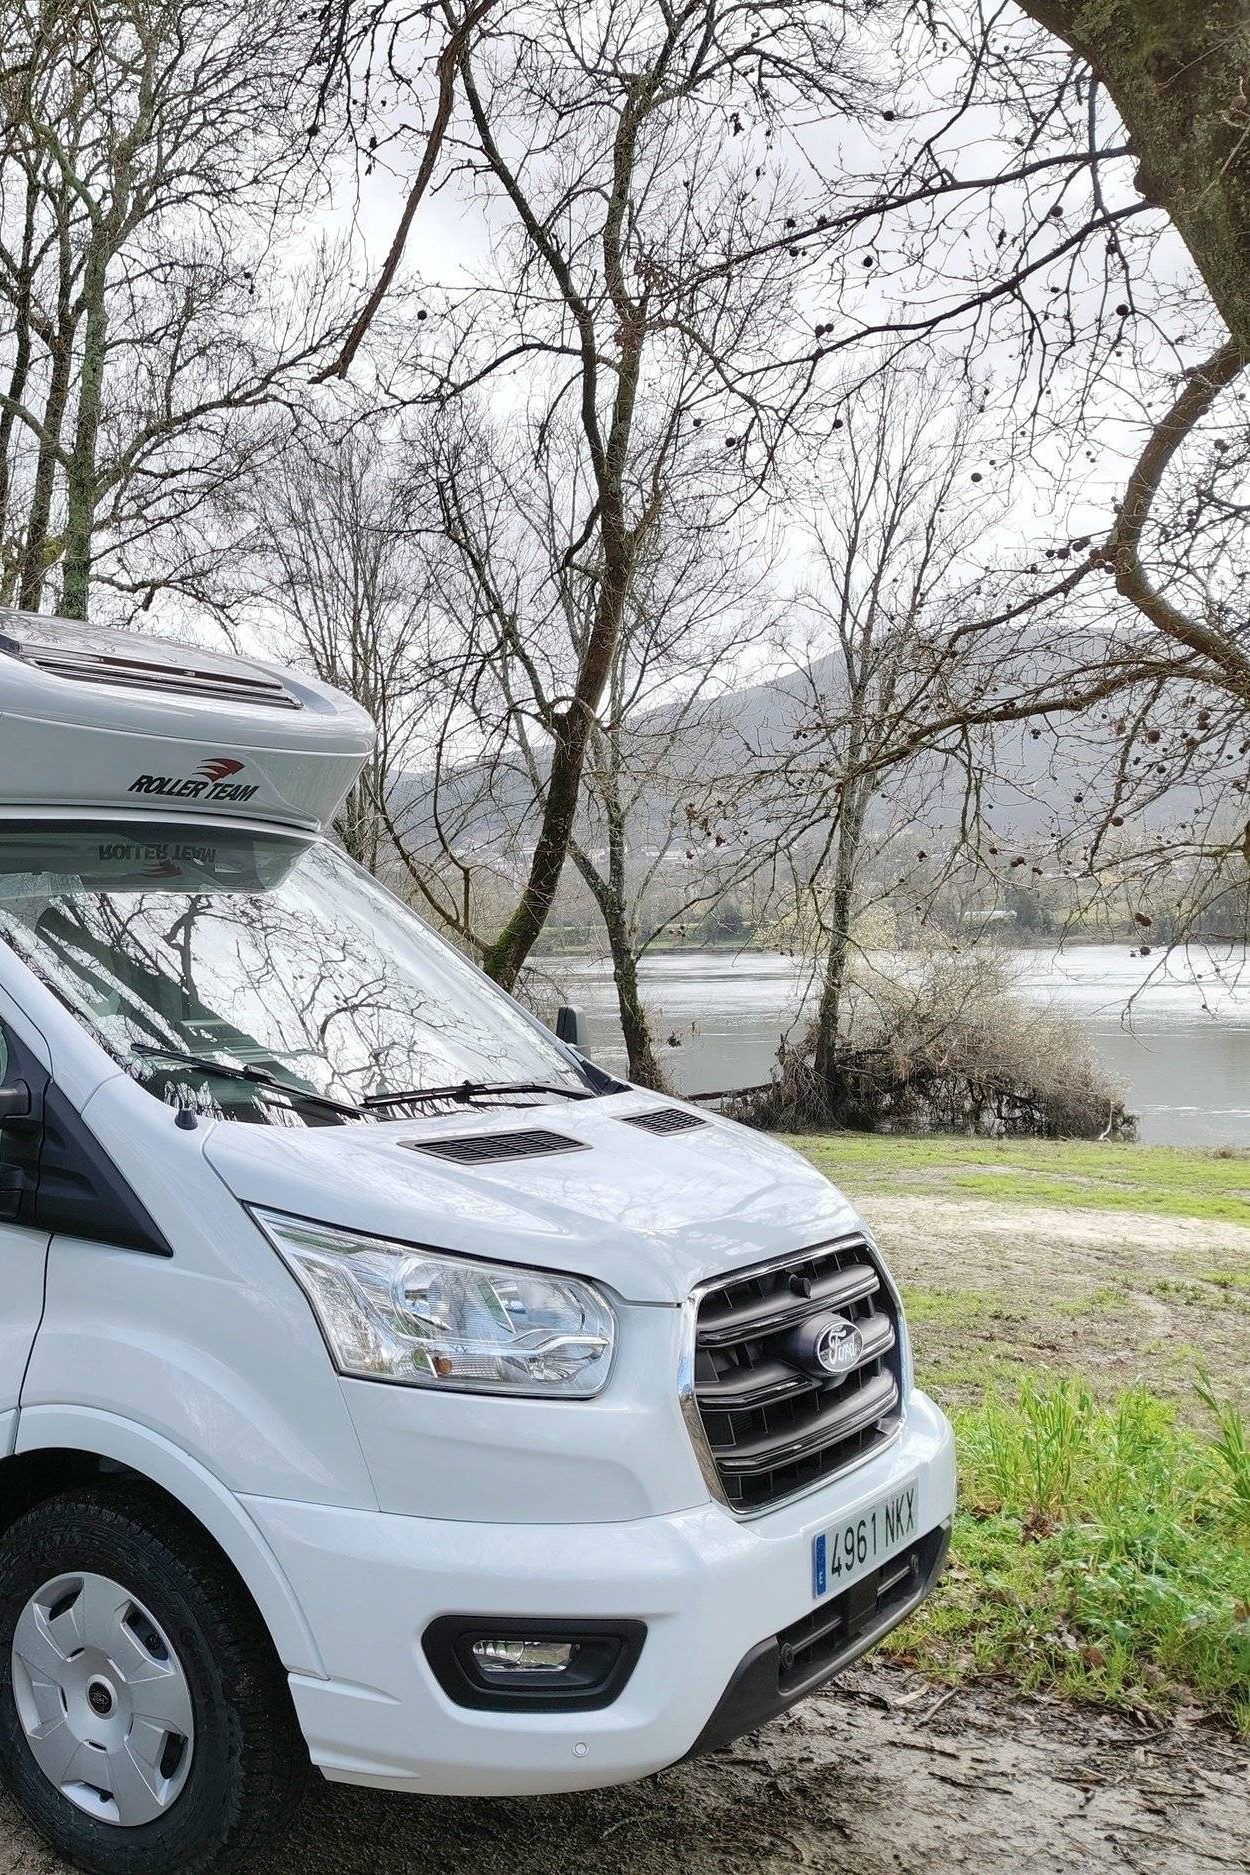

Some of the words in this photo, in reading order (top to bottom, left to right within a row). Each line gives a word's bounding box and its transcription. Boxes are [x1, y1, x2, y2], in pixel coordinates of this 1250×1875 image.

[127, 774, 210, 799] ROLLER
[204, 782, 260, 802] TEAM
[827, 1328, 856, 1365] Ford
[831, 1512, 877, 1577] 4961
[885, 1488, 914, 1548] NKX
